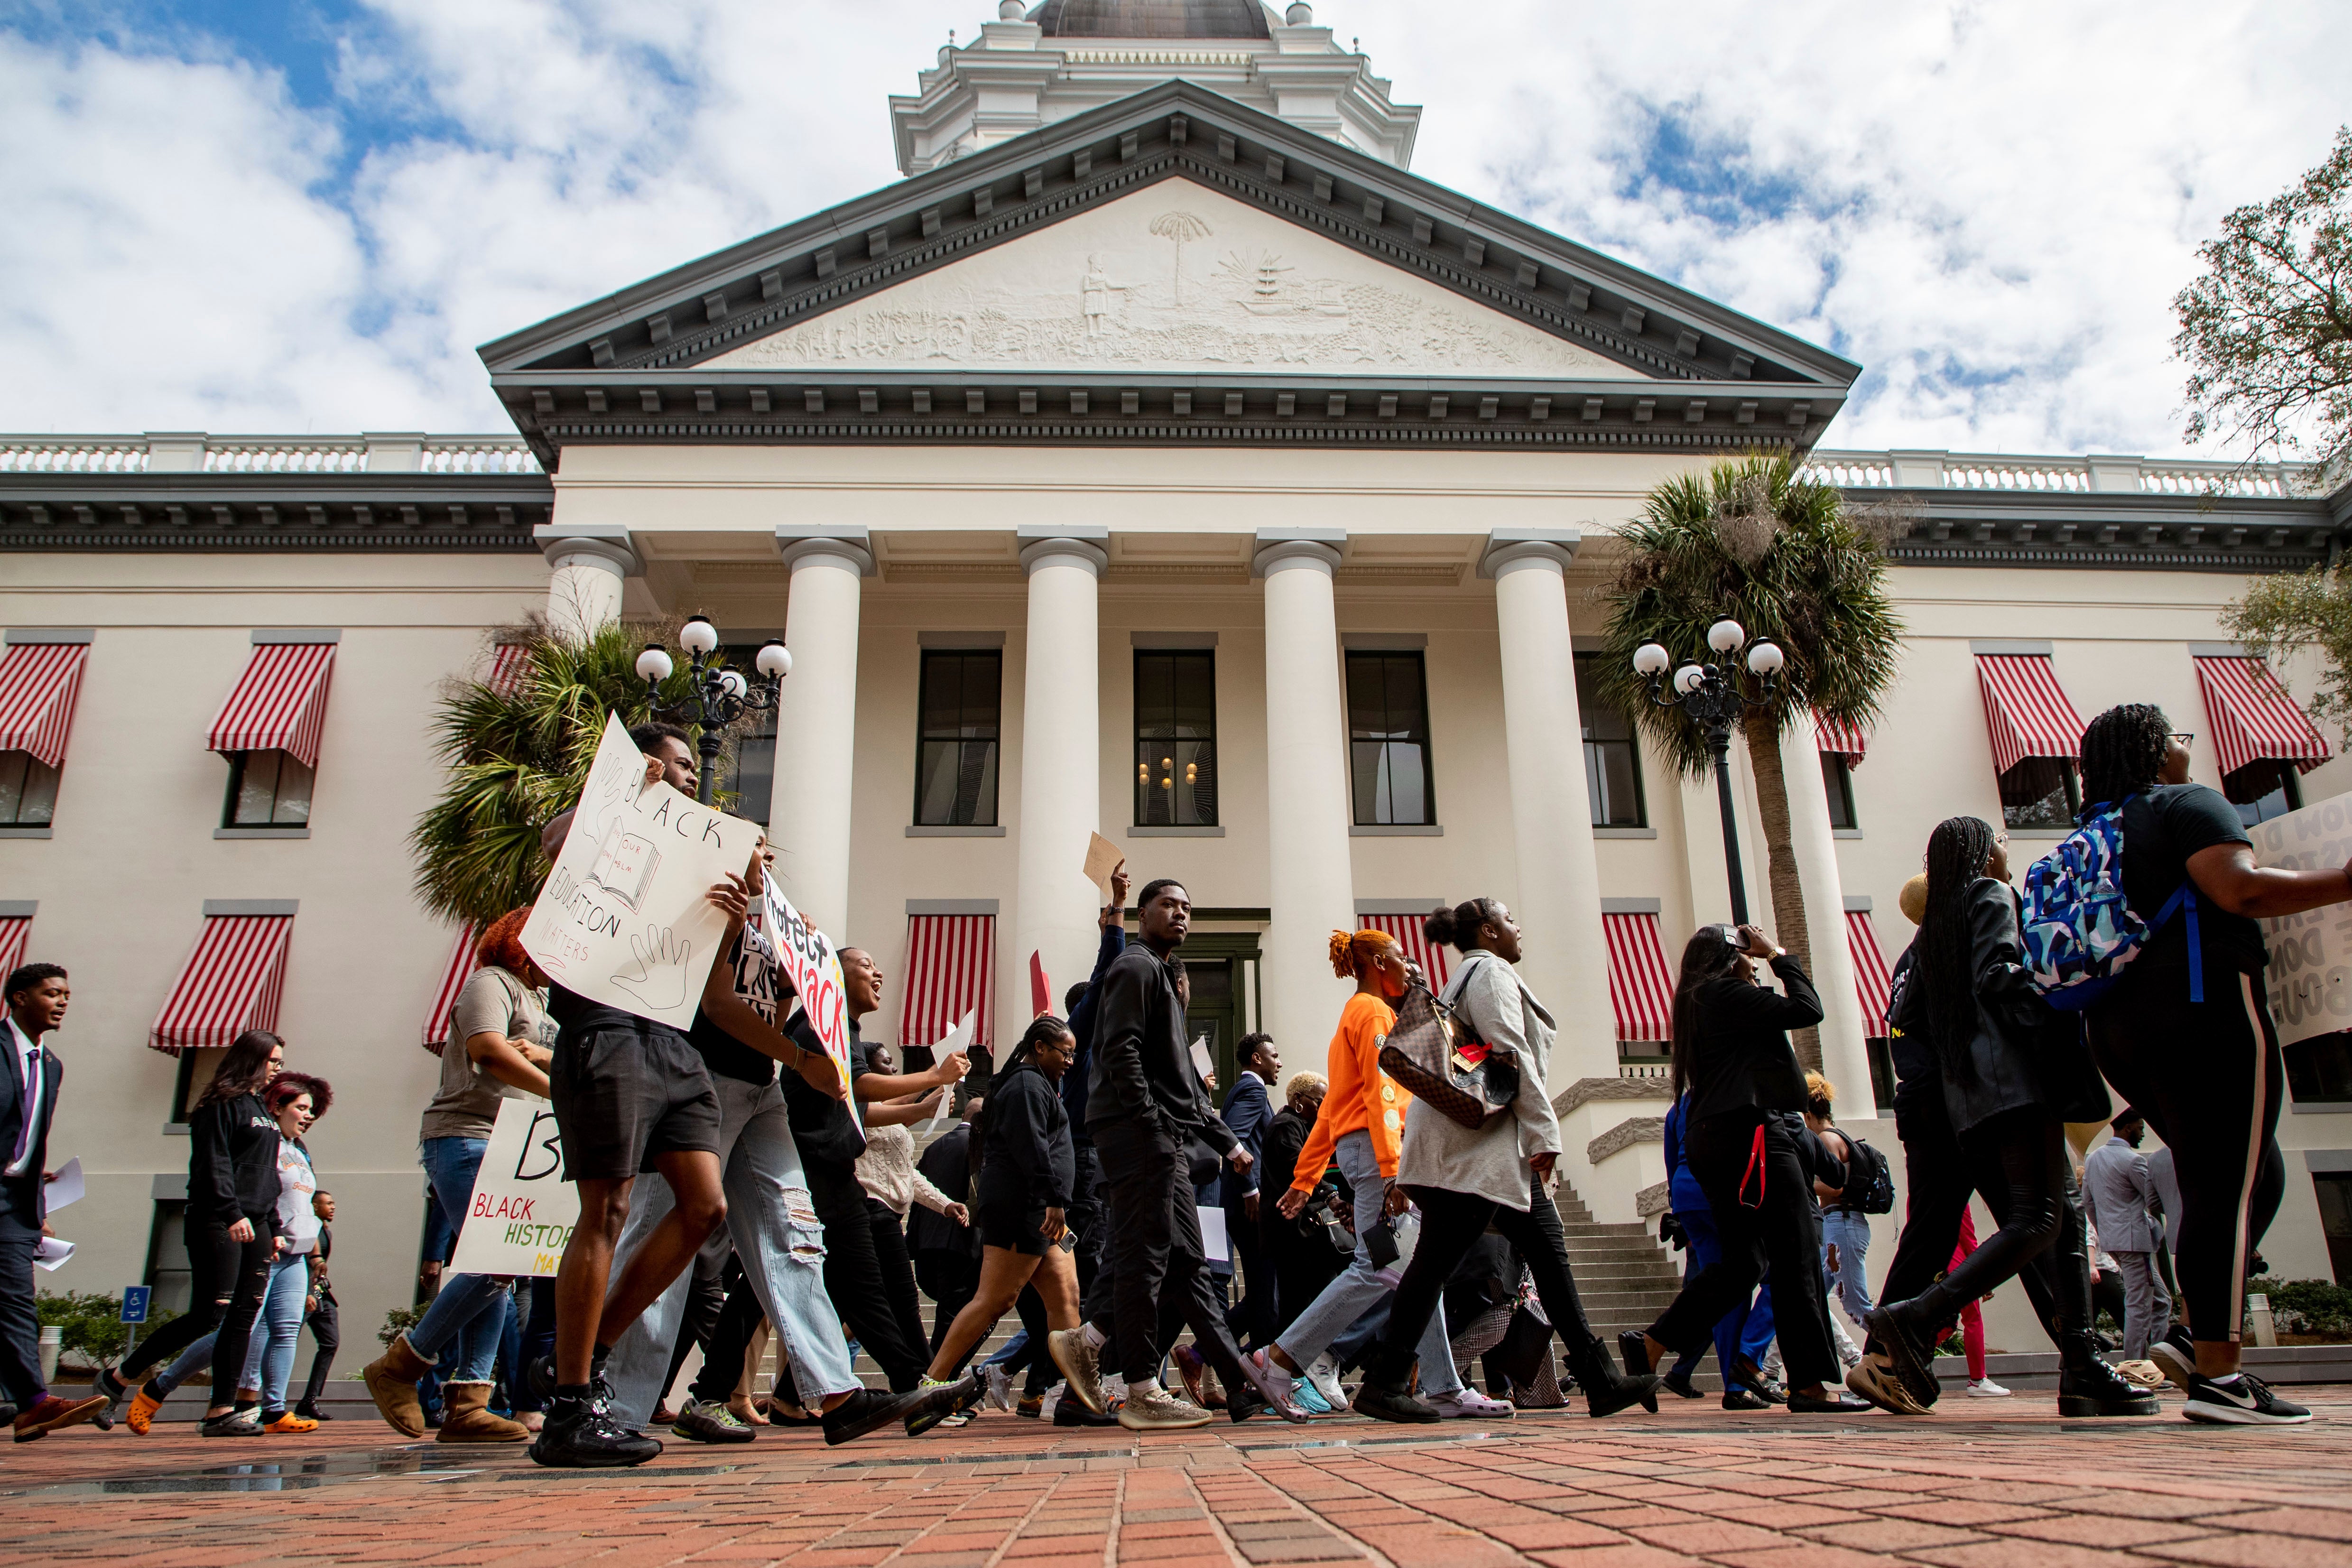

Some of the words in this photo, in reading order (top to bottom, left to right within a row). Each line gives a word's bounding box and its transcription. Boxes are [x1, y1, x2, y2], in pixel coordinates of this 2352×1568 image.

[625, 769, 721, 848] BLACK
[622, 839, 640, 854] OUR
[614, 860, 631, 873] #BLM
[549, 866, 621, 938] EDUCATION
[537, 918, 589, 961] MATTERS
[735, 954, 778, 1003] LIVE
[473, 1193, 536, 1221] BLACK
[504, 1223, 575, 1248] HISTOR
[532, 1253, 561, 1274] MAT
